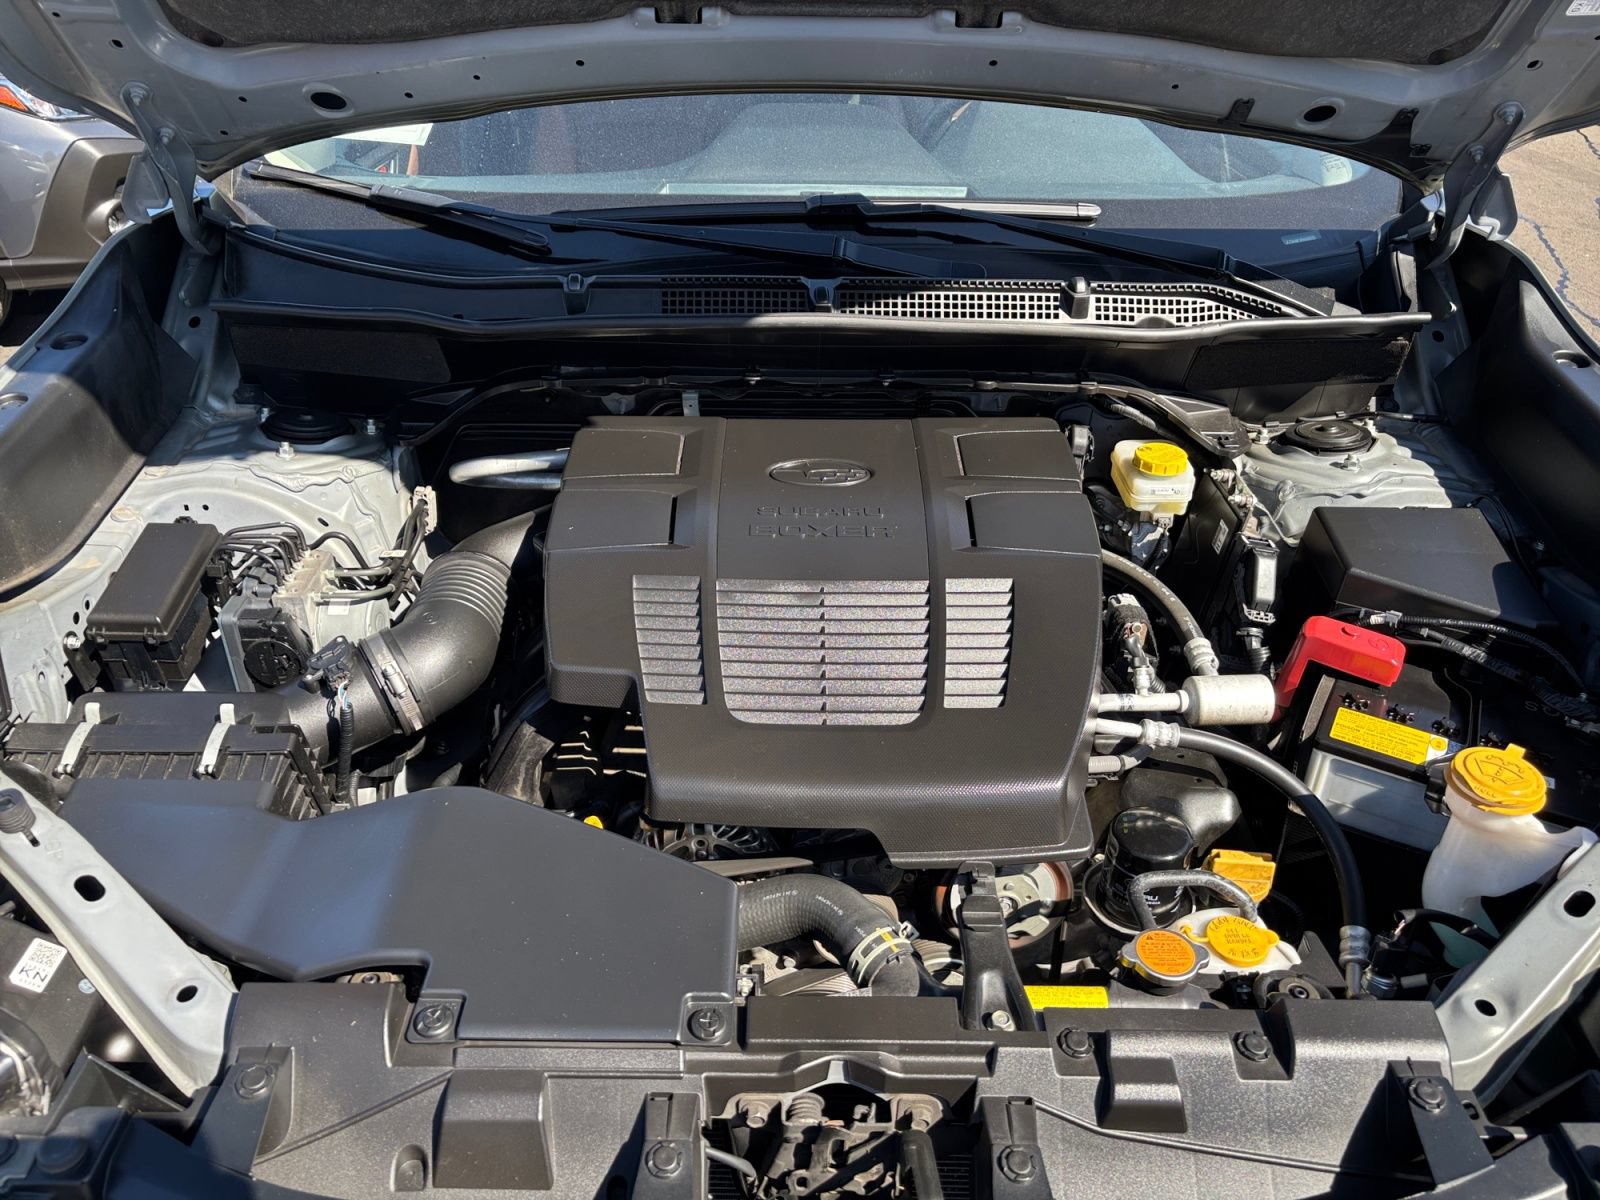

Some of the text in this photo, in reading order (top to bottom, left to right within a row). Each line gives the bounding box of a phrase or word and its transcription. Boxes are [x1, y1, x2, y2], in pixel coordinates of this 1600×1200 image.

[756, 505, 885, 519] SUBARU
[748, 523, 894, 538] BOXER
[18, 966, 48, 983] KN
